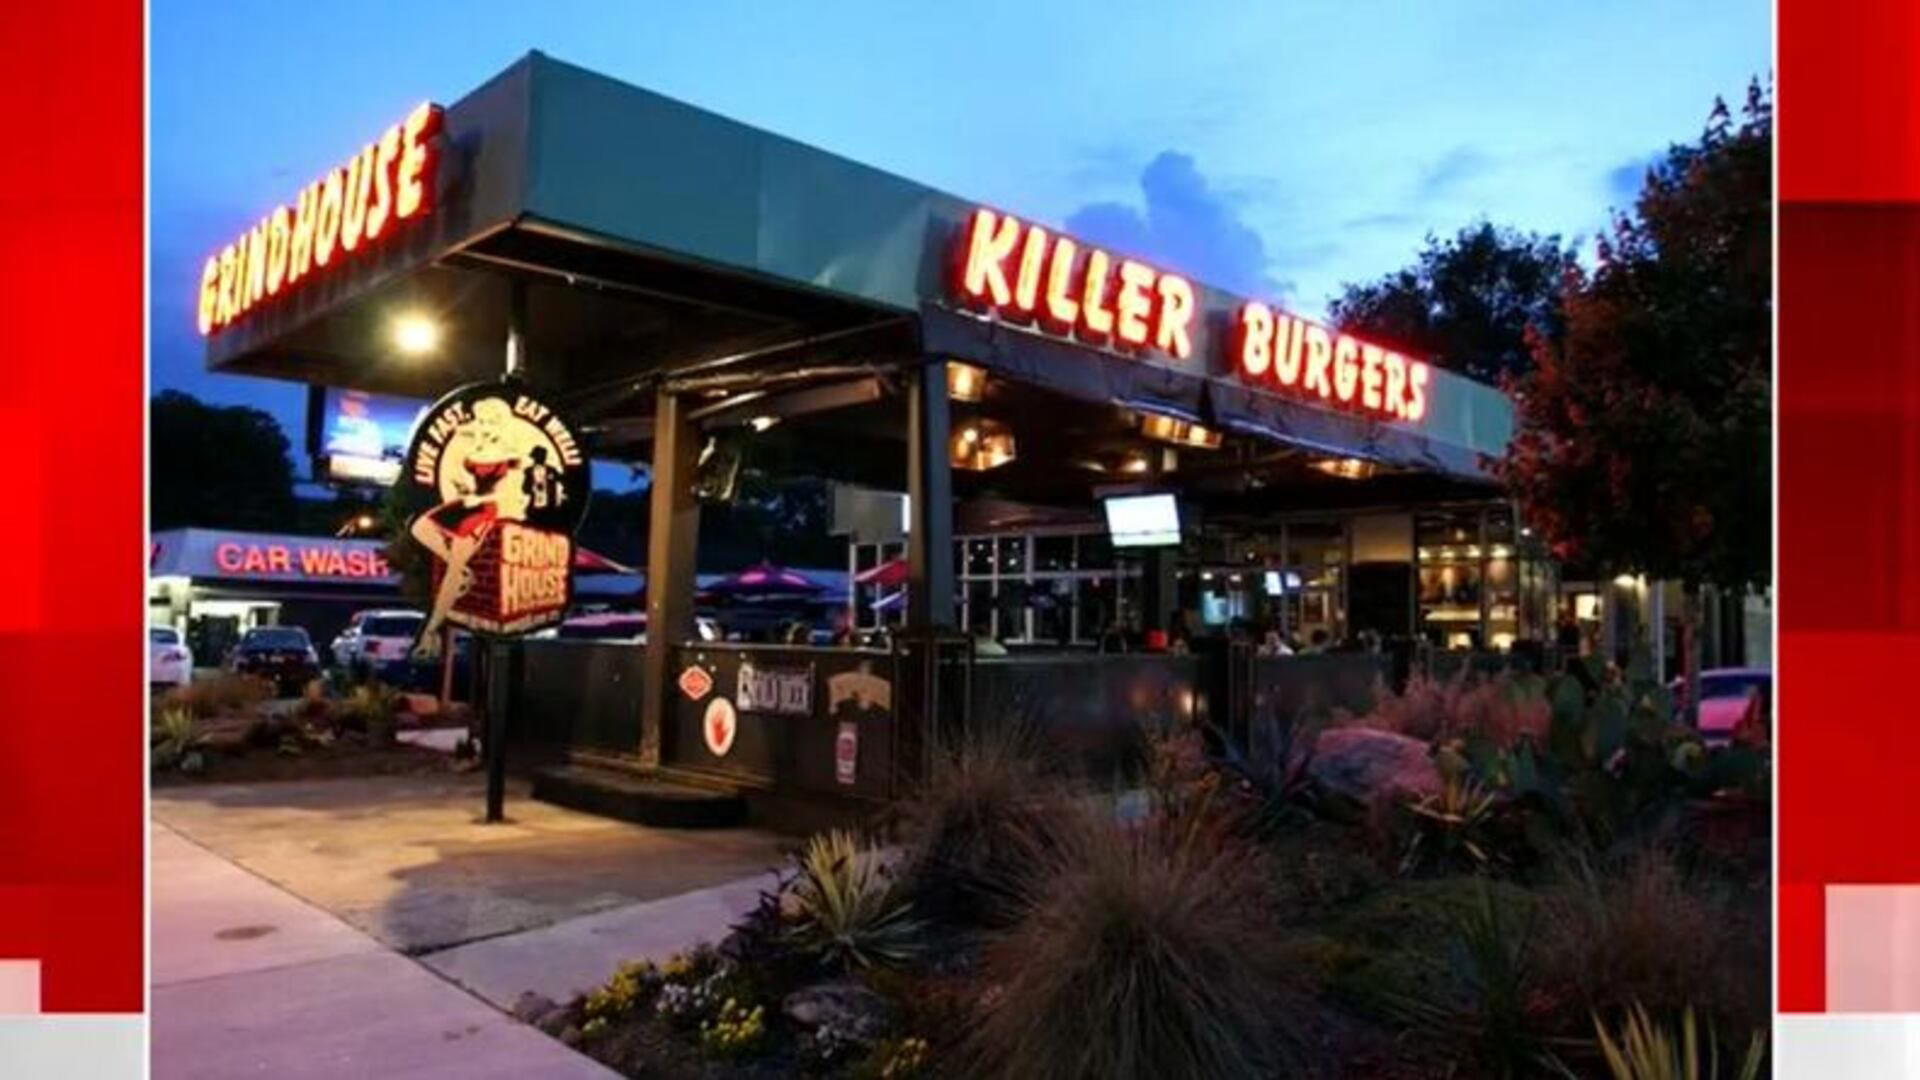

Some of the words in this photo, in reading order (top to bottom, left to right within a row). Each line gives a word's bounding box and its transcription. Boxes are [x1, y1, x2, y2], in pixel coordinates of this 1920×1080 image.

[199, 102, 432, 335] GRINDHOUSE
[964, 208, 1194, 360] KILLER
[1242, 302, 1428, 420] BURGERS
[414, 441, 439, 486] LIVE
[514, 394, 550, 422] EAT
[216, 542, 291, 573] CAR
[300, 548, 389, 578] WASH
[501, 523, 569, 568] GRIND
[501, 565, 567, 615] HOUSE
